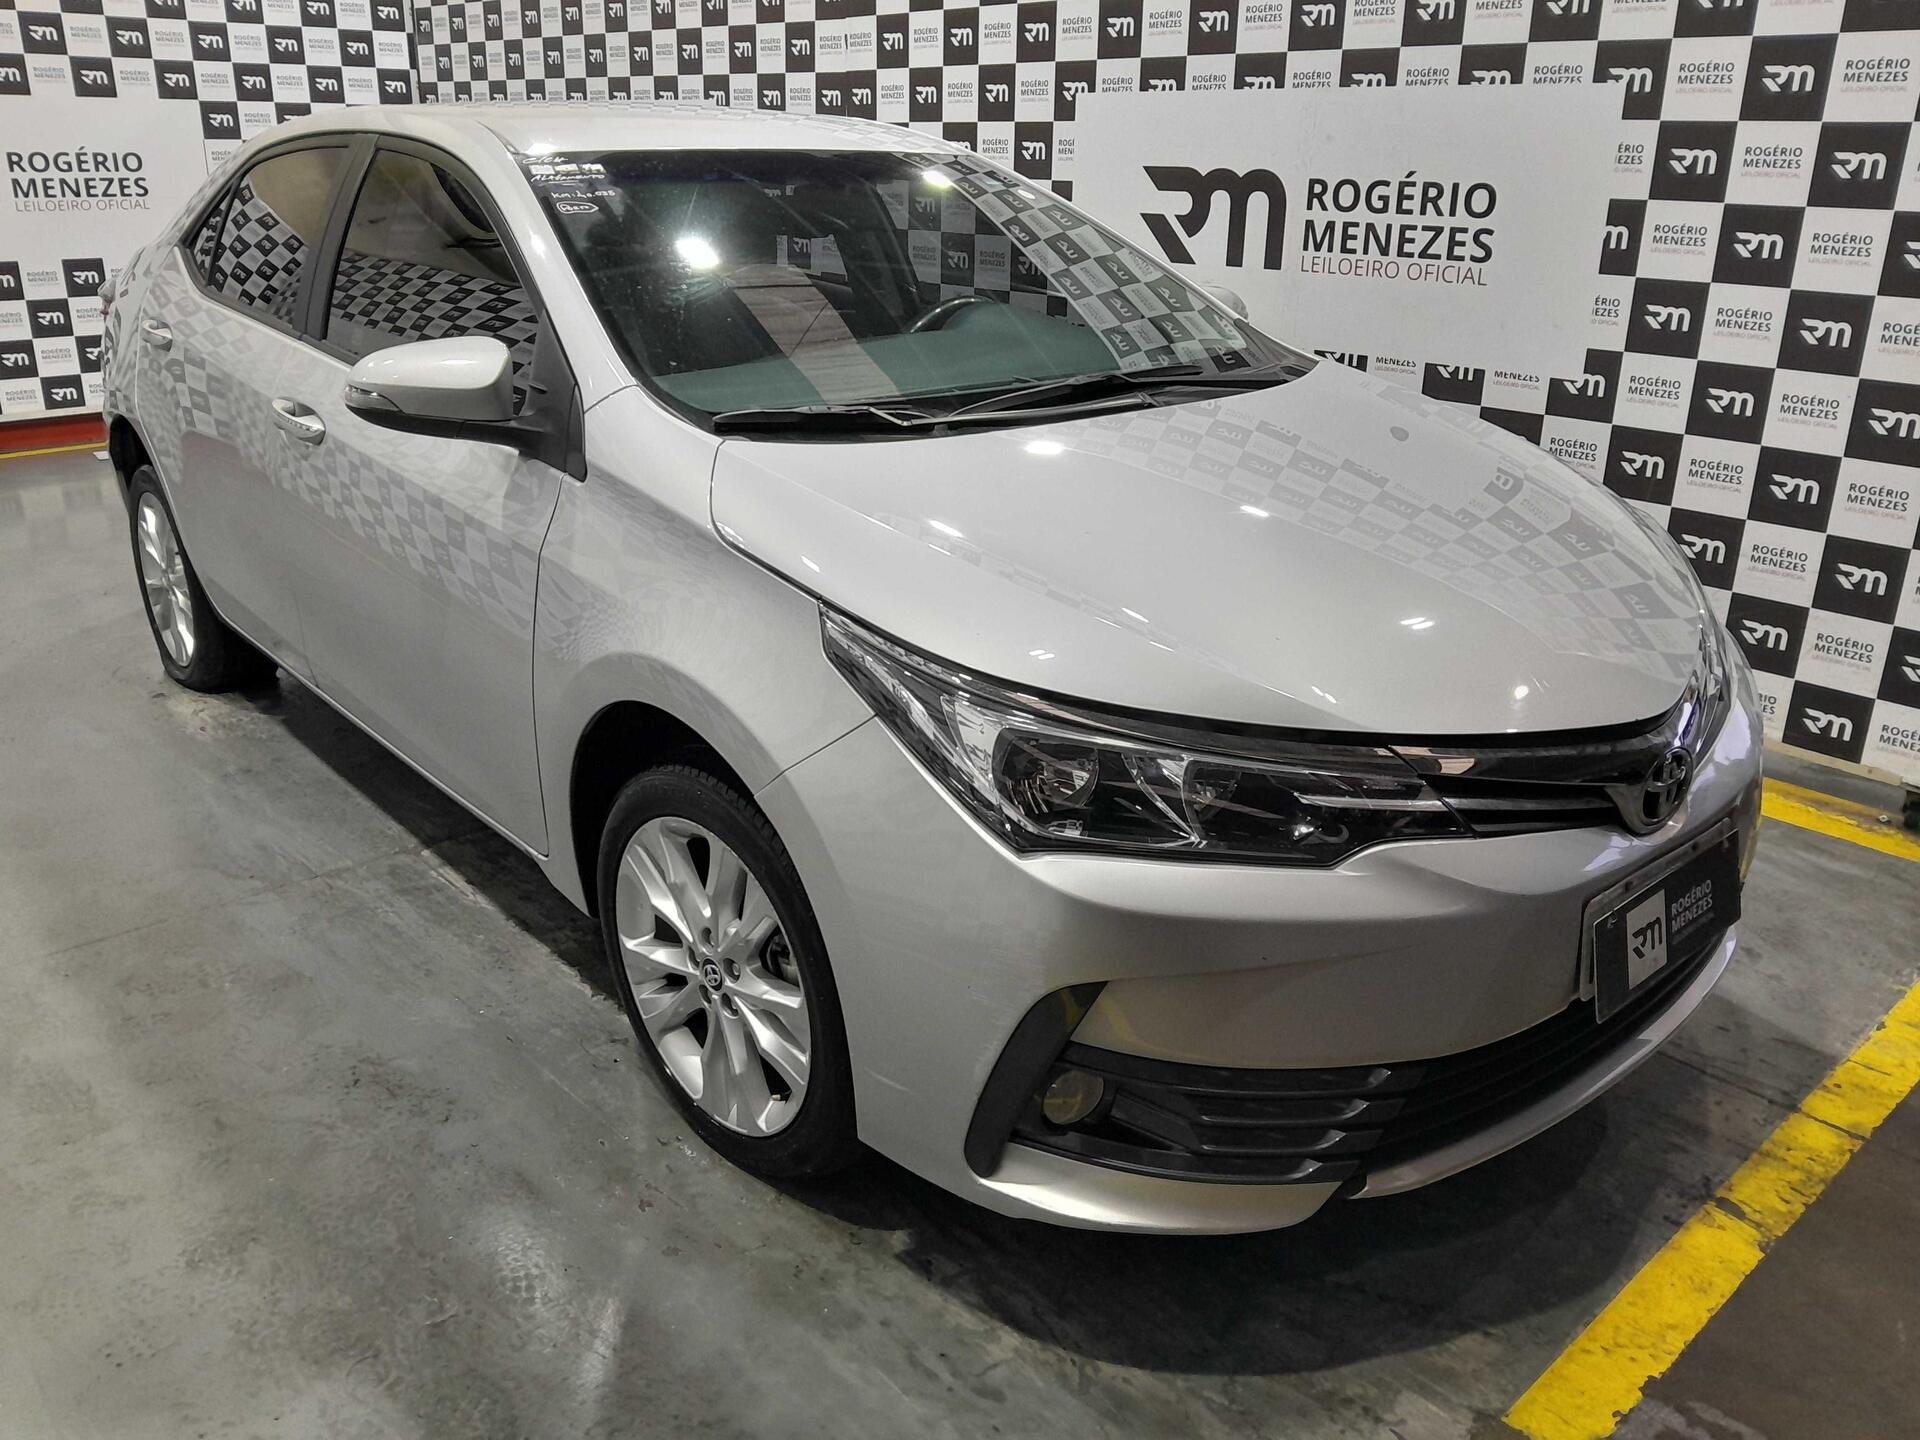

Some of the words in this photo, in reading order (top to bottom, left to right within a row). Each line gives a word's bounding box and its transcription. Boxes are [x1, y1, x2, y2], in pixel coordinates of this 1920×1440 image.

[1246, 2, 1283, 13] ROGÉRIO
[1353, 6, 1396, 17] MENEZES
[1476, 0, 1523, 10] MENEZES
[1062, 16, 1093, 27] ROGÉRIO
[1150, 10, 1183, 20] ROGÉRIO
[1245, 12, 1282, 23] MENEZES
[984, 21, 1011, 31] ROGÉRIO
[1062, 25, 1092, 34] MENEZES
[1149, 19, 1182, 29] MENEZES
[819, 34, 842, 42] ROGÉRIO
[850, 31, 872, 40] ROGÉRIO
[914, 27, 938, 36] ROGÉRIO
[984, 30, 1011, 39] MENEZES
[850, 39, 872, 47] MENEZES
[913, 35, 939, 43] MENEZES
[819, 42, 842, 50] MENEZES
[1534, 64, 1583, 75] ROGÉRIO
[1679, 59, 1735, 74] ROGÉRIO
[1845, 56, 1911, 71] ROGÉRIO
[1192, 73, 1227, 83] ROGÉRIO
[1293, 70, 1332, 81] ROGÉRIO
[1406, 67, 1449, 78] ROGÉRIO
[1677, 73, 1733, 85] MENEZES
[1843, 69, 1909, 82] MENEZES
[881, 83, 905, 92] ROGÉRIO
[947, 81, 973, 90] ROGÉRIO
[1021, 79, 1049, 88] ROGÉRIO
[1102, 76, 1133, 86] ROGÉRIO
[881, 91, 905, 99] MENEZES
[947, 89, 973, 98] MENEZES
[1020, 87, 1049, 96] MENEZES
[982, 138, 1009, 146] ROGÉRIO
[982, 146, 1009, 154] MENEZES
[1744, 143, 1803, 157] ROGÉRIO
[5, 145, 143, 173] ROGÉRIO
[1742, 157, 1801, 169] MENEZES
[11, 177, 149, 199] MENEZES
[1305, 170, 1497, 219] ROGÉRIO
[15, 199, 93, 212] LEILOEIRO
[95, 199, 150, 211] OFICIAL
[1654, 223, 1708, 236] ROGÉRIO
[1301, 219, 1494, 264] MENEZES
[1652, 235, 1706, 248] MENEZES
[1812, 232, 1873, 246] ROGÉRIO
[1810, 244, 1872, 258] MENEZES
[1300, 253, 1400, 280] LEILOEIRO
[1406, 263, 1487, 286] OFICIAL
[1717, 306, 1773, 322] ROGÉRIO
[1715, 318, 1771, 333] MENEZES
[1375, 356, 1417, 368] MENEZES
[1494, 370, 1540, 383] MENEZES
[1629, 375, 1681, 390] ROGÉRIO
[1628, 385, 1680, 401] MENEZES
[1782, 393, 1840, 410] ROGÉRIO
[1779, 404, 1838, 421] MENEZES
[1550, 437, 1597, 452] ROGÉRIO
[1549, 447, 1596, 462] MENEZES
[1690, 458, 1744, 475] ROGÉRIO
[1688, 469, 1743, 485] MENEZES
[1849, 483, 1910, 501] ROGÉRIO
[1847, 493, 1907, 512] MENEZES
[1752, 544, 1808, 563] ROGÉRIO
[1750, 554, 1806, 573] MENEZES
[1816, 632, 1875, 653] ROGÉRIO
[1814, 642, 1873, 664] MENEZES
[1671, 879, 1712, 917] ROGÉRIO
[1671, 895, 1713, 933] MENEZES
